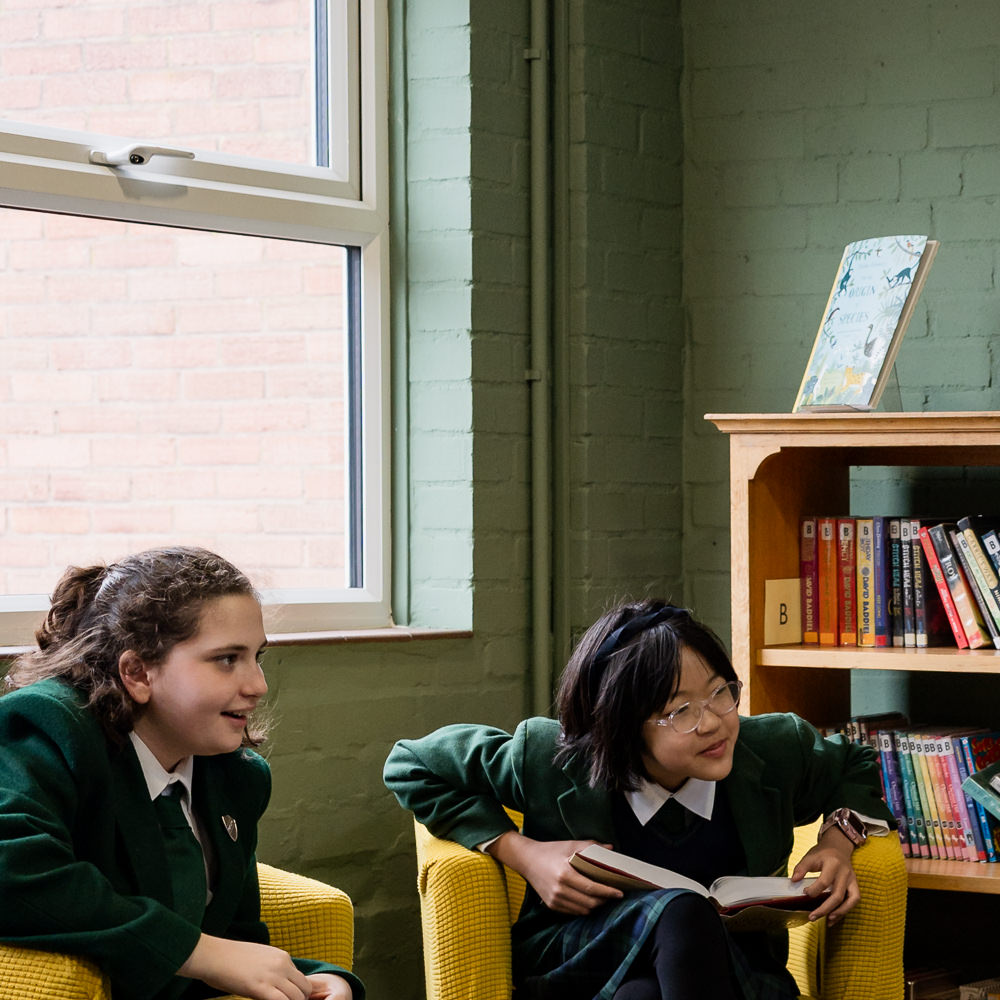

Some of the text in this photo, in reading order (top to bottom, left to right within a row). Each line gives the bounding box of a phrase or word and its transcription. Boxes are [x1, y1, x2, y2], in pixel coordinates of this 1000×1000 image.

[912, 545, 920, 568] STITCH
[913, 570, 921, 588] HEAD
[780, 603, 788, 625] B
[884, 739, 889, 748] B
[902, 742, 908, 750] B
[910, 742, 915, 750] B
[930, 743, 935, 752] B
[945, 742, 950, 750] B
[916, 744, 922, 752] B
[924, 744, 930, 752] B
[937, 744, 943, 752] B
